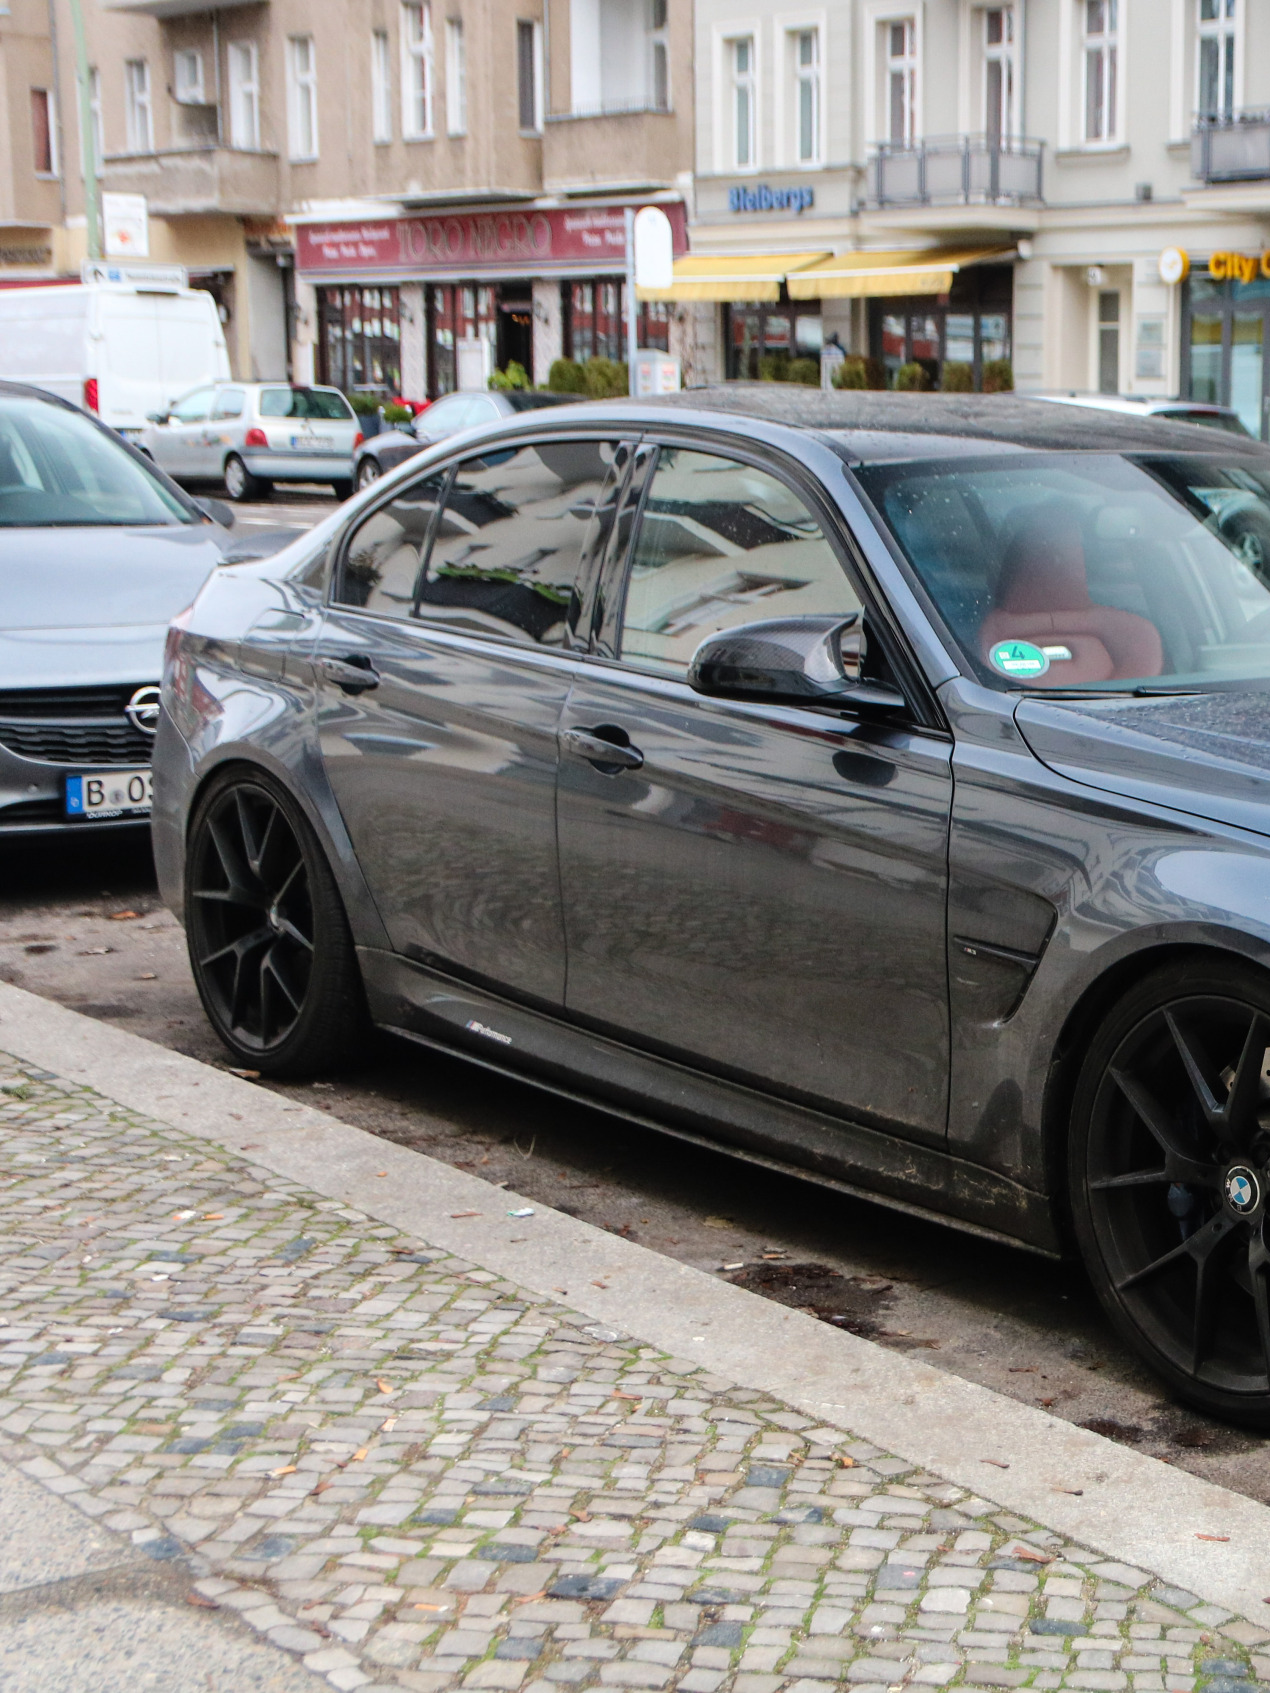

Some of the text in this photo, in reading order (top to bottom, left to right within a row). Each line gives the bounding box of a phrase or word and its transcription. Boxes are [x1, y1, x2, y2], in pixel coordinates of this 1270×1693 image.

[396, 217, 464, 263] TORO
[470, 212, 552, 260] NIGRO
[1208, 251, 1258, 284] City
[87, 775, 152, 807] B O
